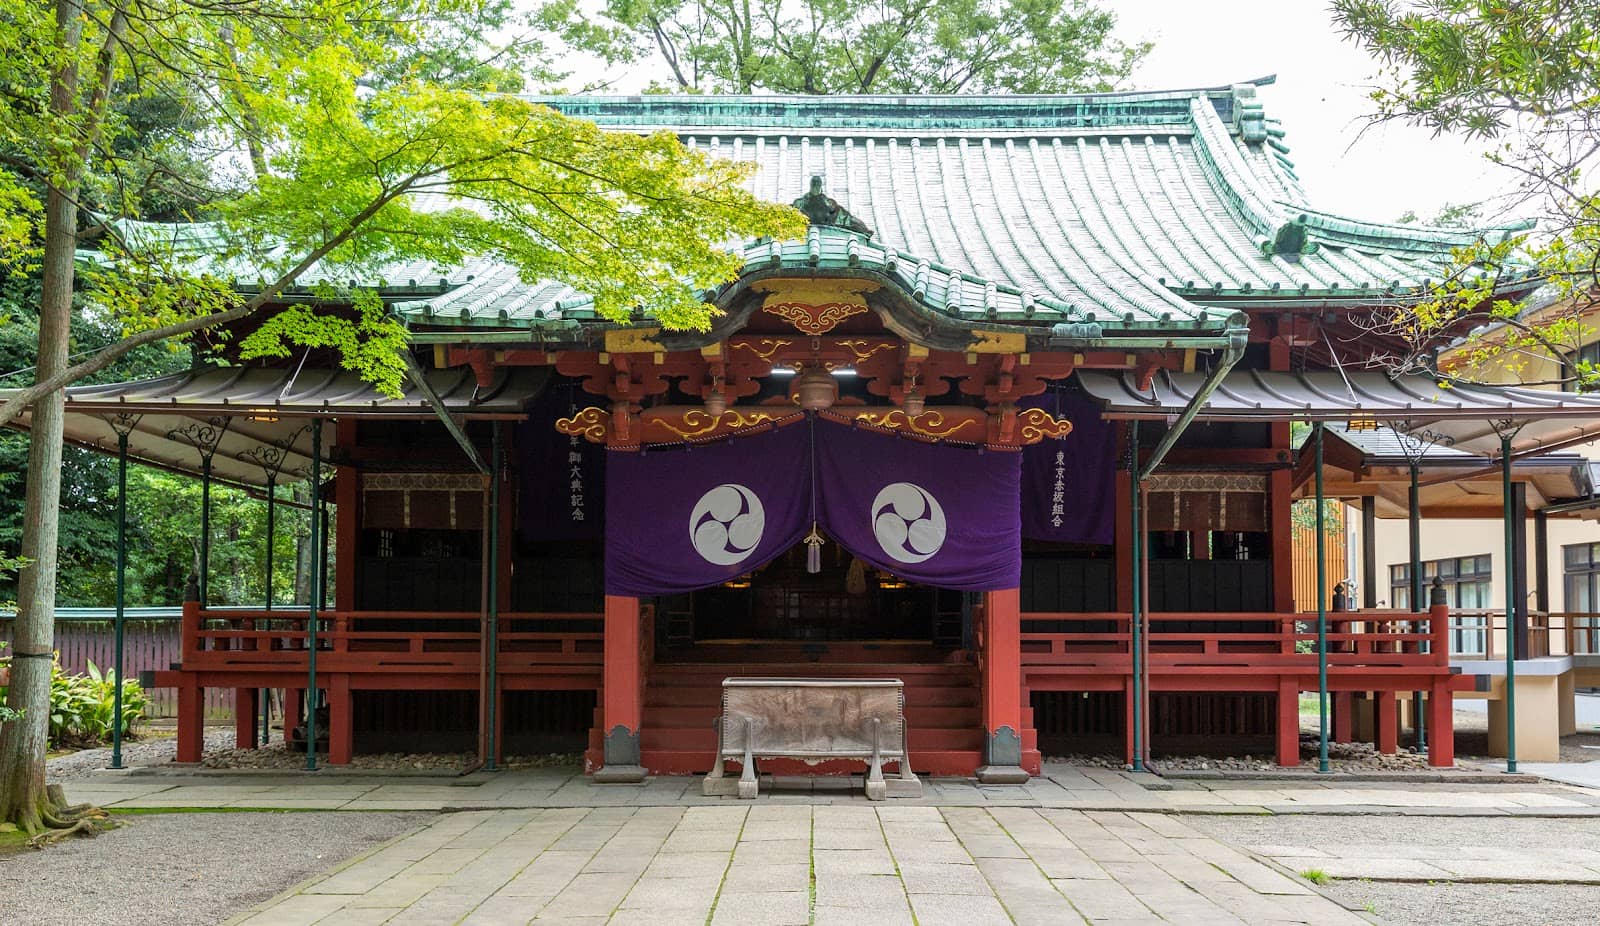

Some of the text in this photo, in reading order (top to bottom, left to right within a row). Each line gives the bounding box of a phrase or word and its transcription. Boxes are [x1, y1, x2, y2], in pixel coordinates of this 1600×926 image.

[1051, 450, 1066, 527] 東京赤坂組合
